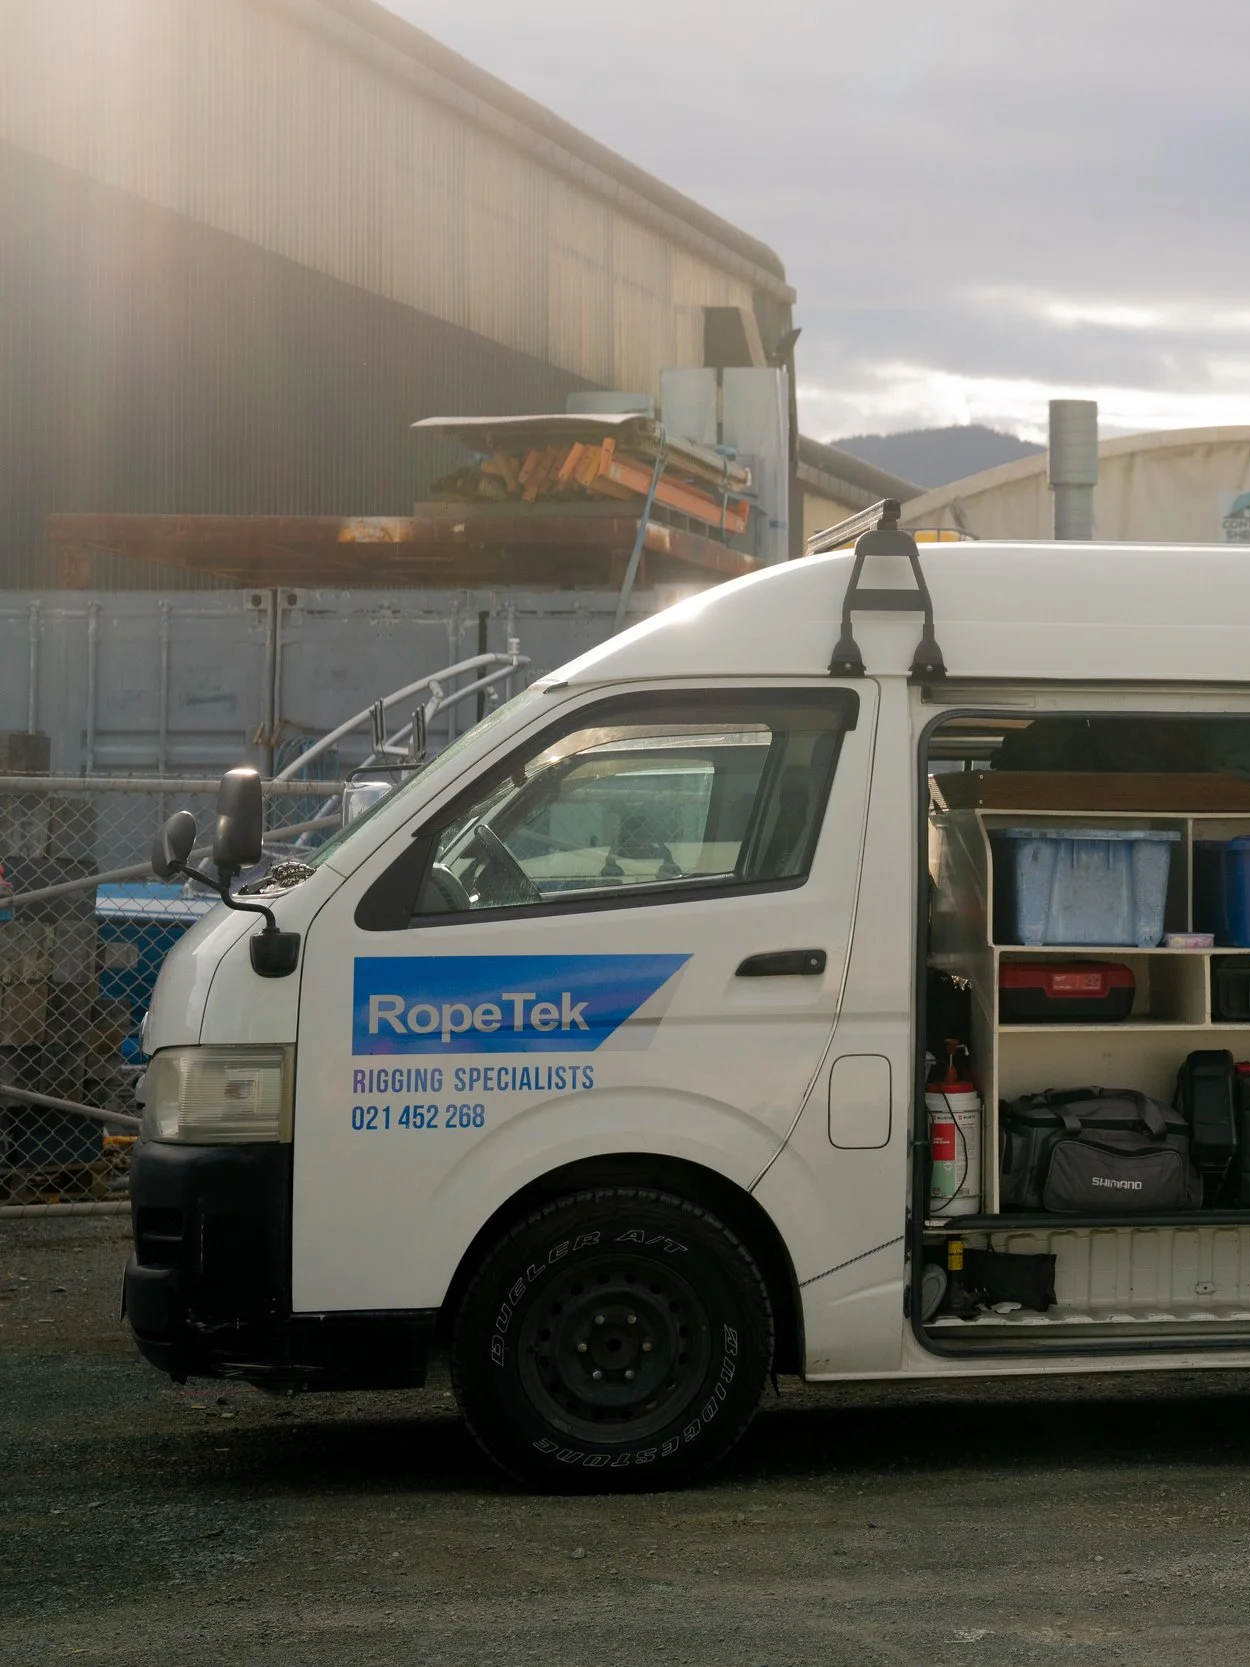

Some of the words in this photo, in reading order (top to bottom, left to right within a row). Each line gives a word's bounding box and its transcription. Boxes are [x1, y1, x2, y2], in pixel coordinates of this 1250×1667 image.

[368, 991, 591, 1043] RopeTek
[352, 1067, 444, 1094] RIGGING
[454, 1065, 595, 1092] SPECIALISTS
[351, 1105, 391, 1131] 021
[398, 1104, 439, 1129] 452
[445, 1103, 486, 1129] 268
[1091, 1176, 1143, 1190] SHIMANO
[491, 1230, 601, 1367] DUELER
[532, 1323, 739, 1468] BRIDGESTONE
